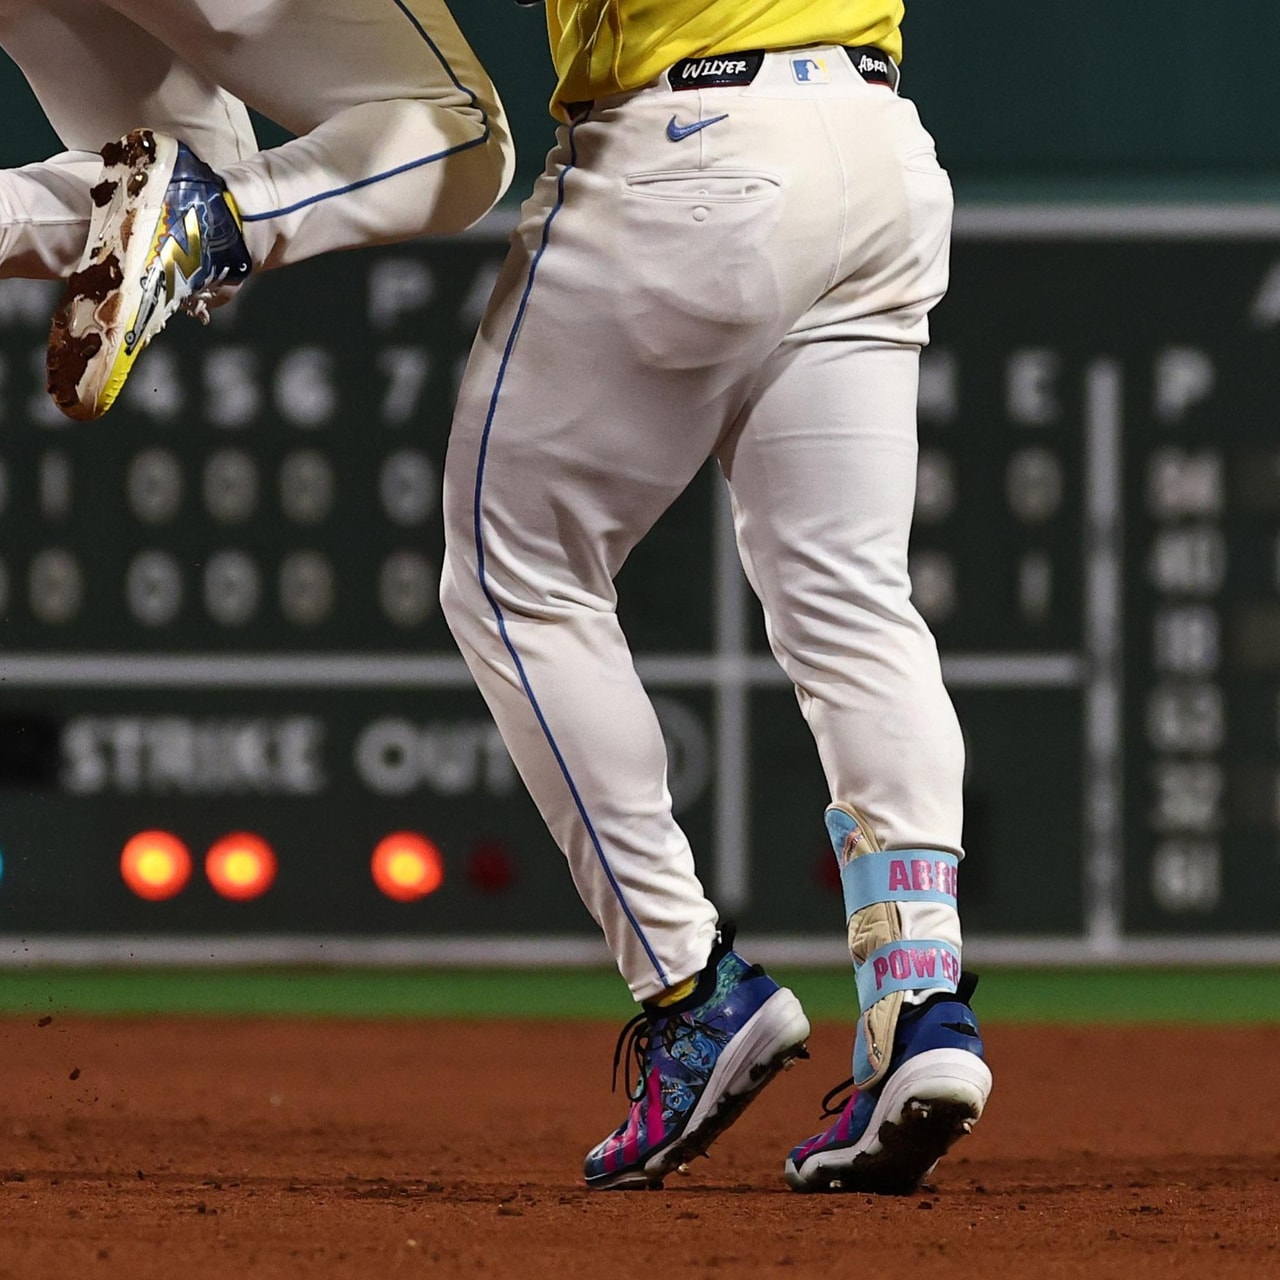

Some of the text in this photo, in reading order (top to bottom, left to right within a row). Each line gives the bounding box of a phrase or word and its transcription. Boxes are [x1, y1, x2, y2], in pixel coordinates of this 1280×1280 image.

[205, 349, 259, 425] 5
[277, 350, 333, 424] 6
[384, 348, 428, 420] 7
[1008, 351, 1052, 422] E
[1157, 349, 1212, 414] P
[40, 453, 70, 515] 1
[128, 450, 182, 521] 0
[204, 450, 257, 520] 0
[280, 451, 333, 522] 0
[380, 448, 434, 523] 0
[30, 550, 82, 621] 0
[128, 552, 182, 625] 0
[205, 551, 259, 623] 0
[280, 552, 333, 623] 0
[380, 550, 433, 623] 0
[65, 717, 320, 793] STRIKE
